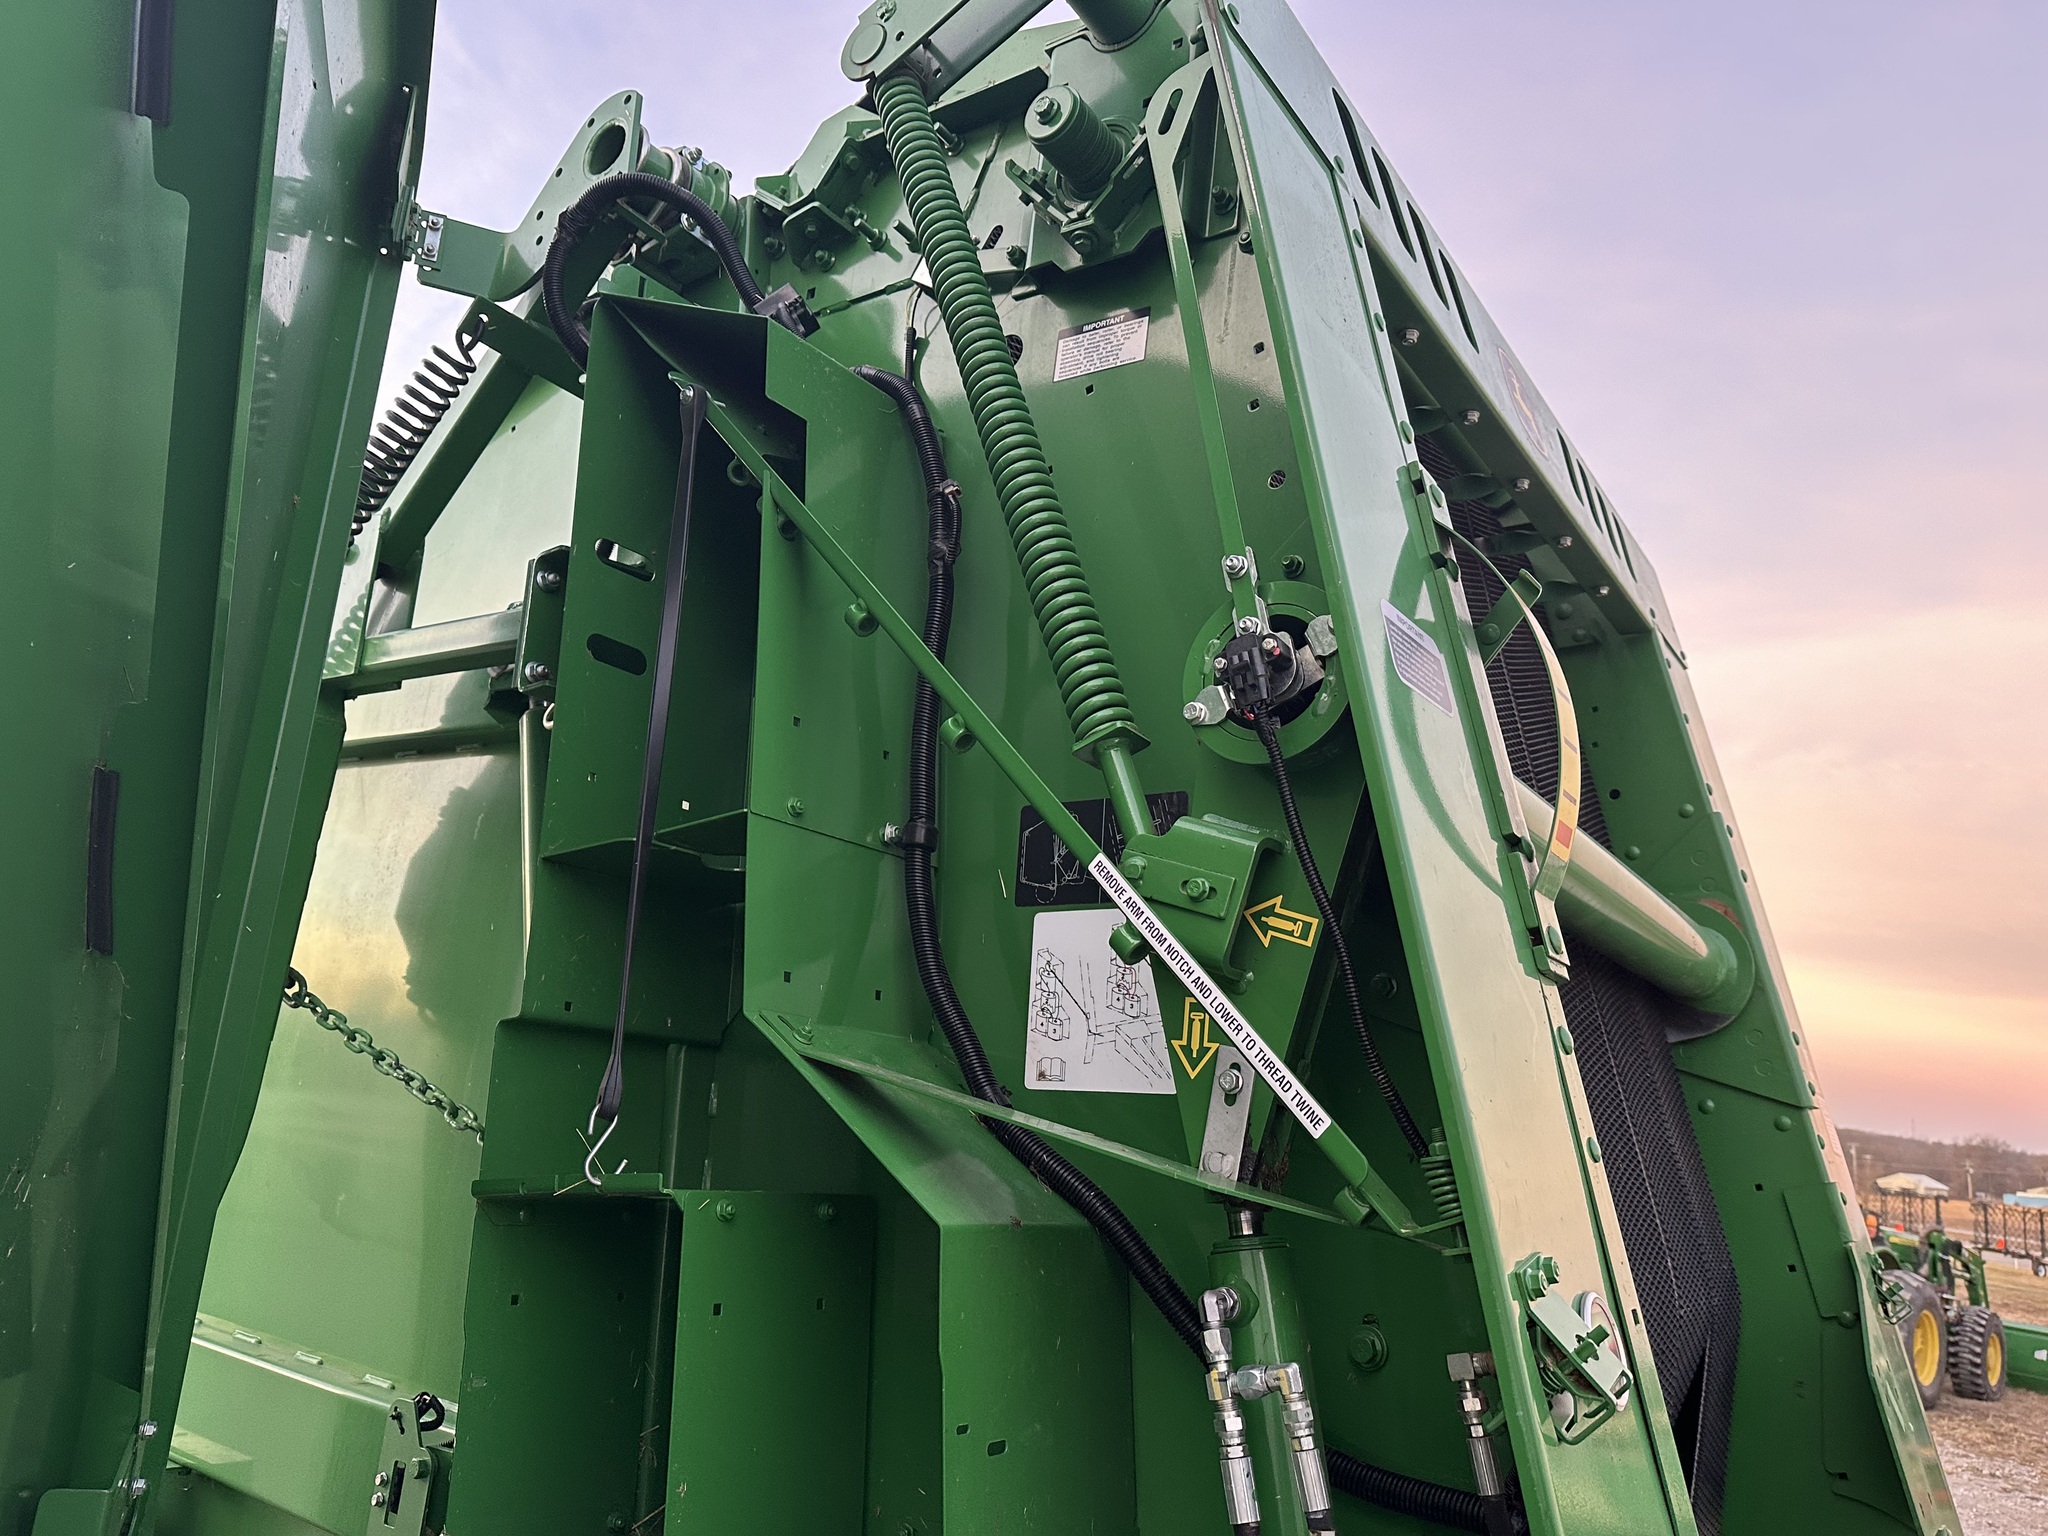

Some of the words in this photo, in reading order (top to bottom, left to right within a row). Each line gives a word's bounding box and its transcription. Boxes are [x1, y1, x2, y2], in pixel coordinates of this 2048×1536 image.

[1083, 315, 1125, 332] IMPORTANT
[1094, 860, 1127, 900] REMOVE
[1123, 897, 1145, 920] ARM
[1141, 916, 1168, 947] FROM
[1164, 943, 1195, 979] NOTCH
[1191, 976, 1213, 1000] AND
[1209, 996, 1244, 1037] LOWER
[1241, 1032, 1256, 1050] TO
[1254, 1047, 1292, 1093] THREAD
[1290, 1090, 1325, 1131] TWINE
